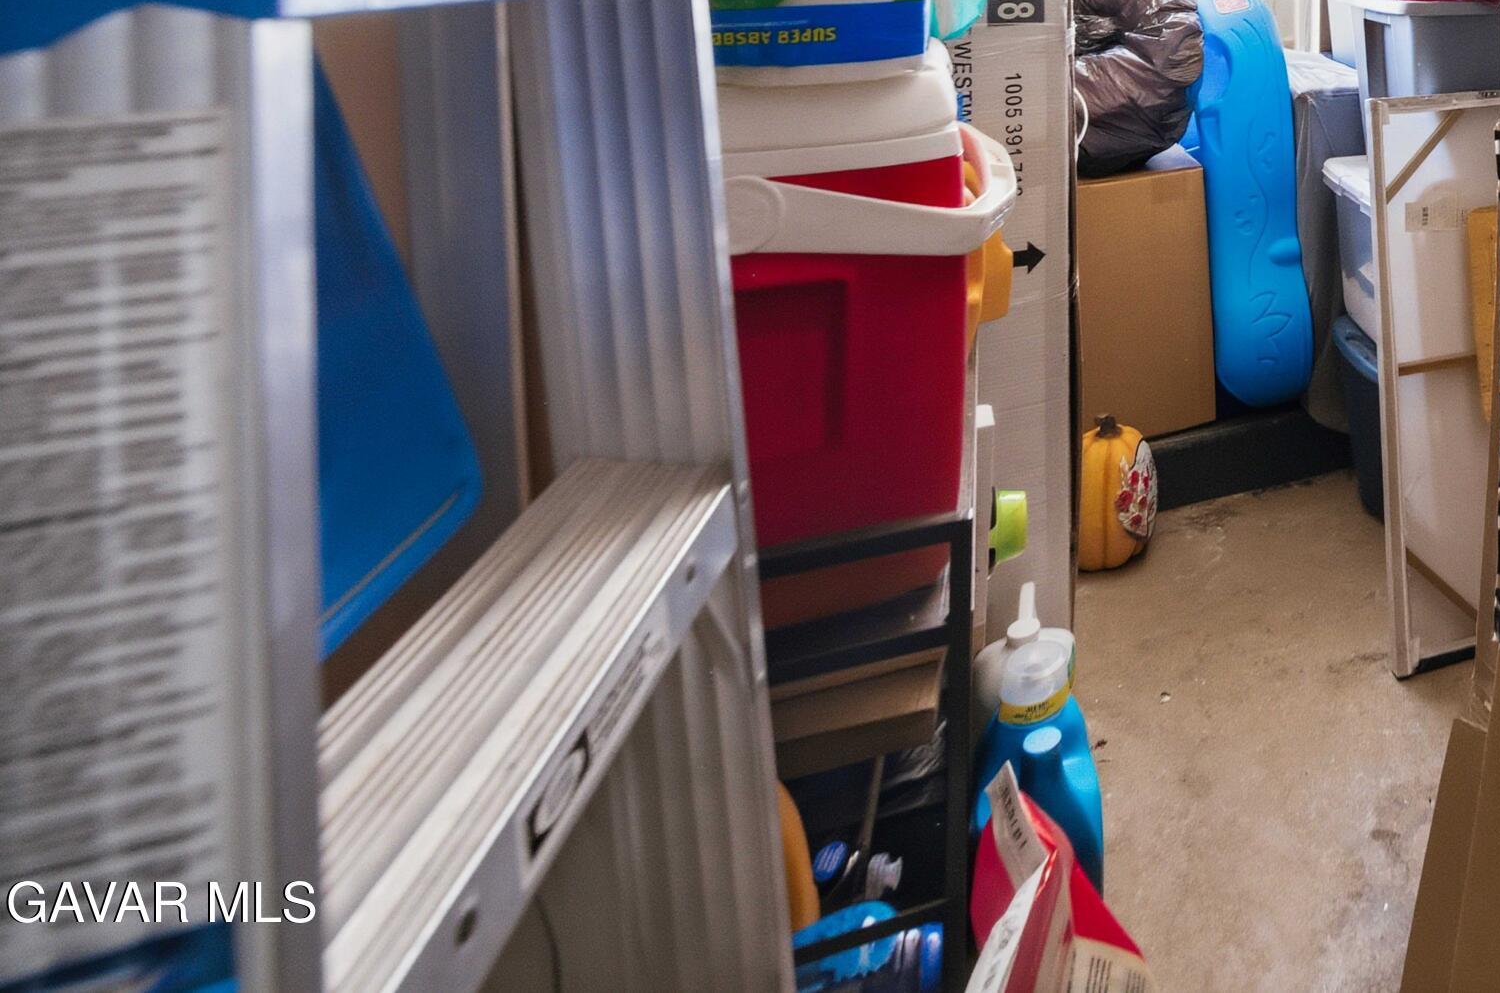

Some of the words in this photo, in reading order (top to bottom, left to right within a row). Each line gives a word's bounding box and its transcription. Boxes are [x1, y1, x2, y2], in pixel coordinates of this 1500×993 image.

[777, 27, 837, 44] SUPER
[1004, 72, 1024, 119] 1005
[1004, 124, 1024, 156] 391
